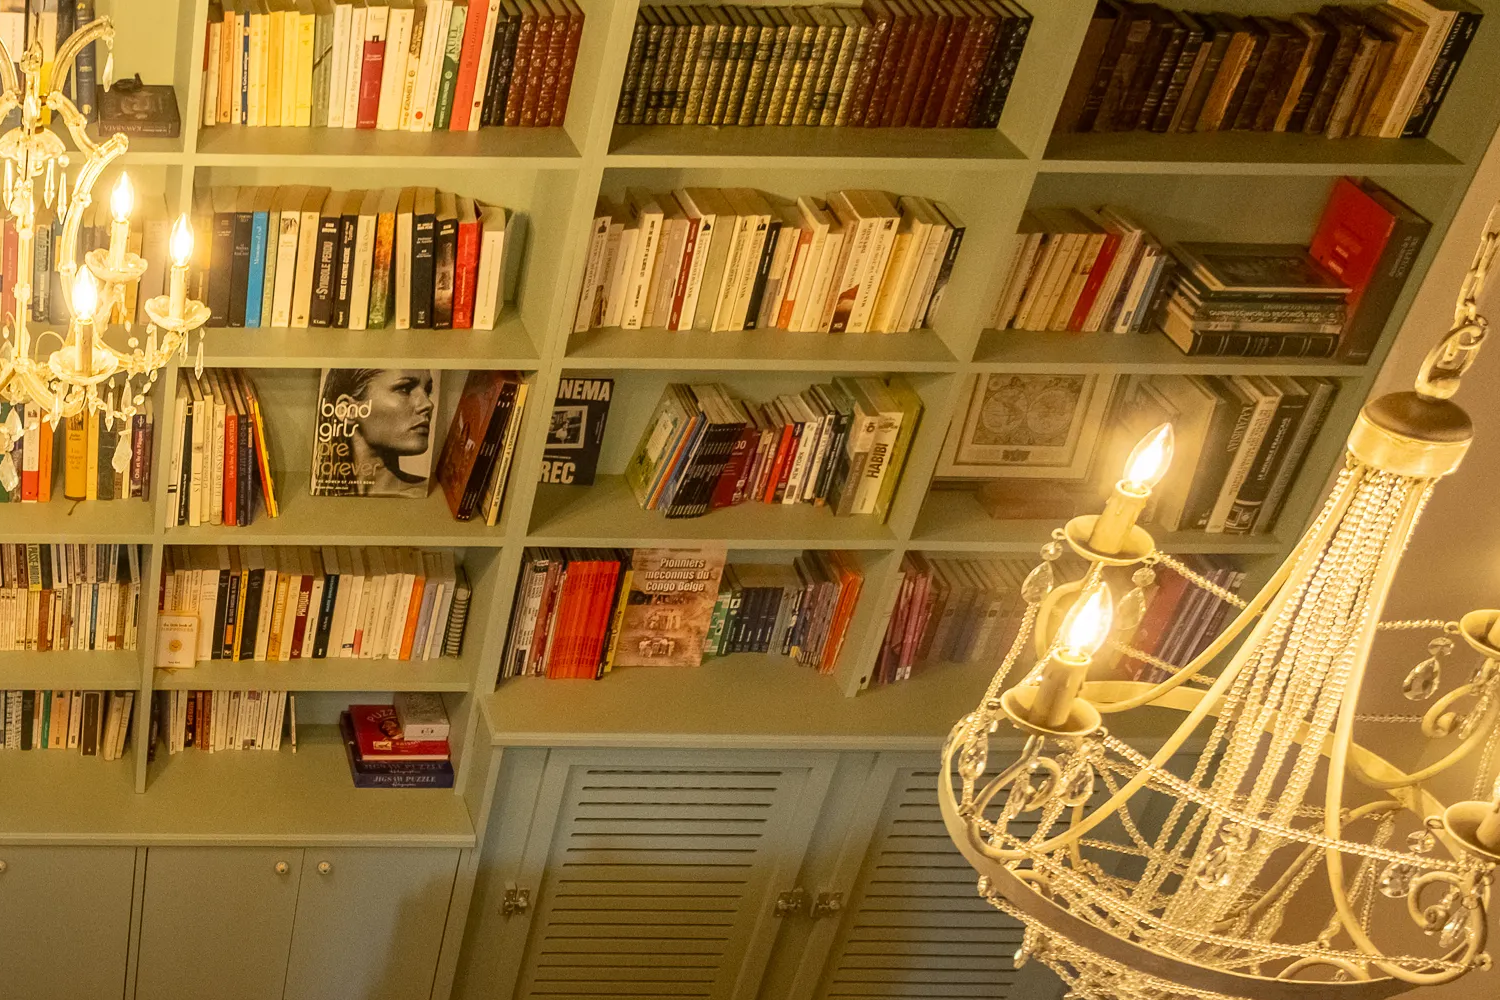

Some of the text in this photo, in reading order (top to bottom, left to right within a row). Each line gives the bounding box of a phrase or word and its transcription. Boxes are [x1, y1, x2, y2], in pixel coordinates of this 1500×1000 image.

[321, 240, 334, 263] PERDU
[315, 262, 331, 295] SYMBOLE
[559, 380, 610, 401] NEMA
[321, 398, 372, 418] bond
[319, 418, 359, 442] girls
[318, 442, 349, 456] are
[317, 459, 380, 476] forever
[791, 450, 805, 479] NEW YORK
[865, 440, 888, 480] HABIBI
[660, 558, 706, 568] Pionniers
[697, 570, 710, 580] du
[645, 582, 705, 592] Congo Belge
[296, 589, 309, 617] PANIQUE
[367, 708, 394, 723] PUZZ
